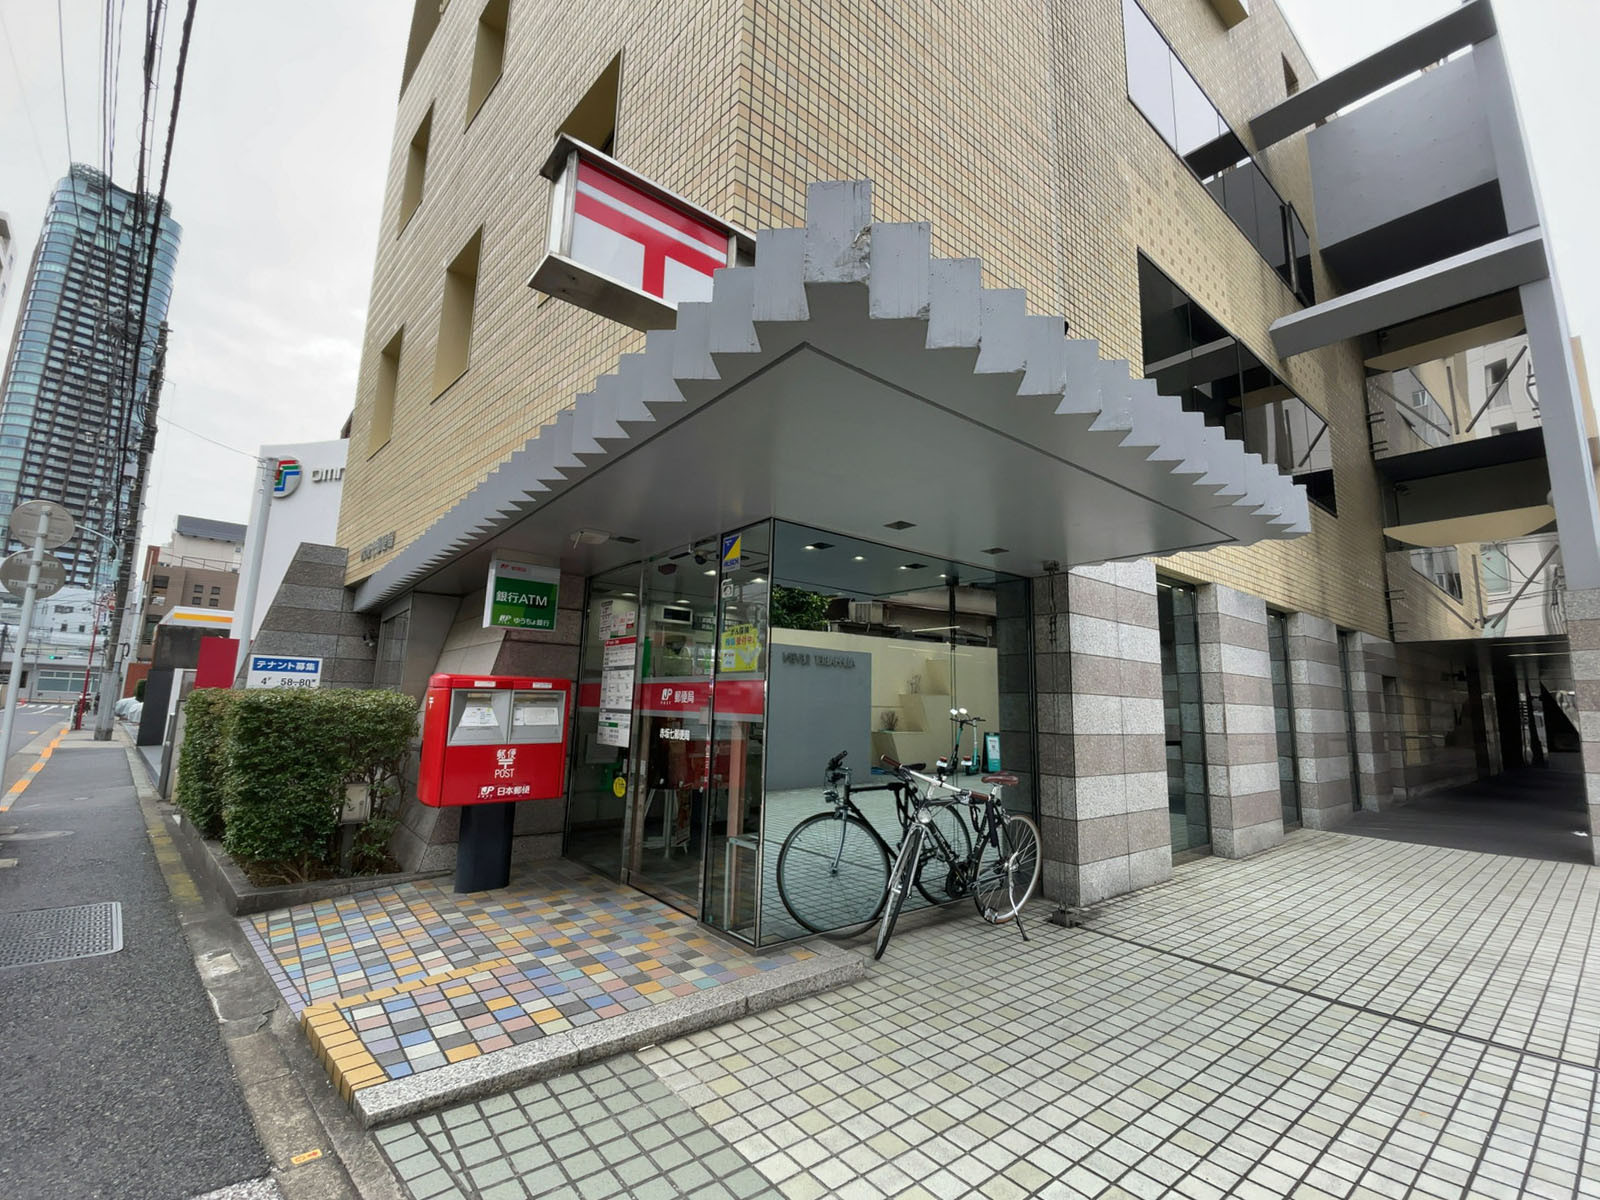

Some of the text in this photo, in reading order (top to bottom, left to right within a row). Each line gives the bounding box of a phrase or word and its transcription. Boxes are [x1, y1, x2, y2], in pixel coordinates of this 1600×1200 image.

[495, 590, 548, 607] 銀行ATM
[513, 617, 550, 627] ゆうちょ銀行
[256, 660, 316, 671] テナント募集
[674, 690, 695, 704] 郵便局
[496, 748, 517, 760] 郵便
[494, 768, 515, 779] POST
[497, 785, 531, 797] 日本郵便
